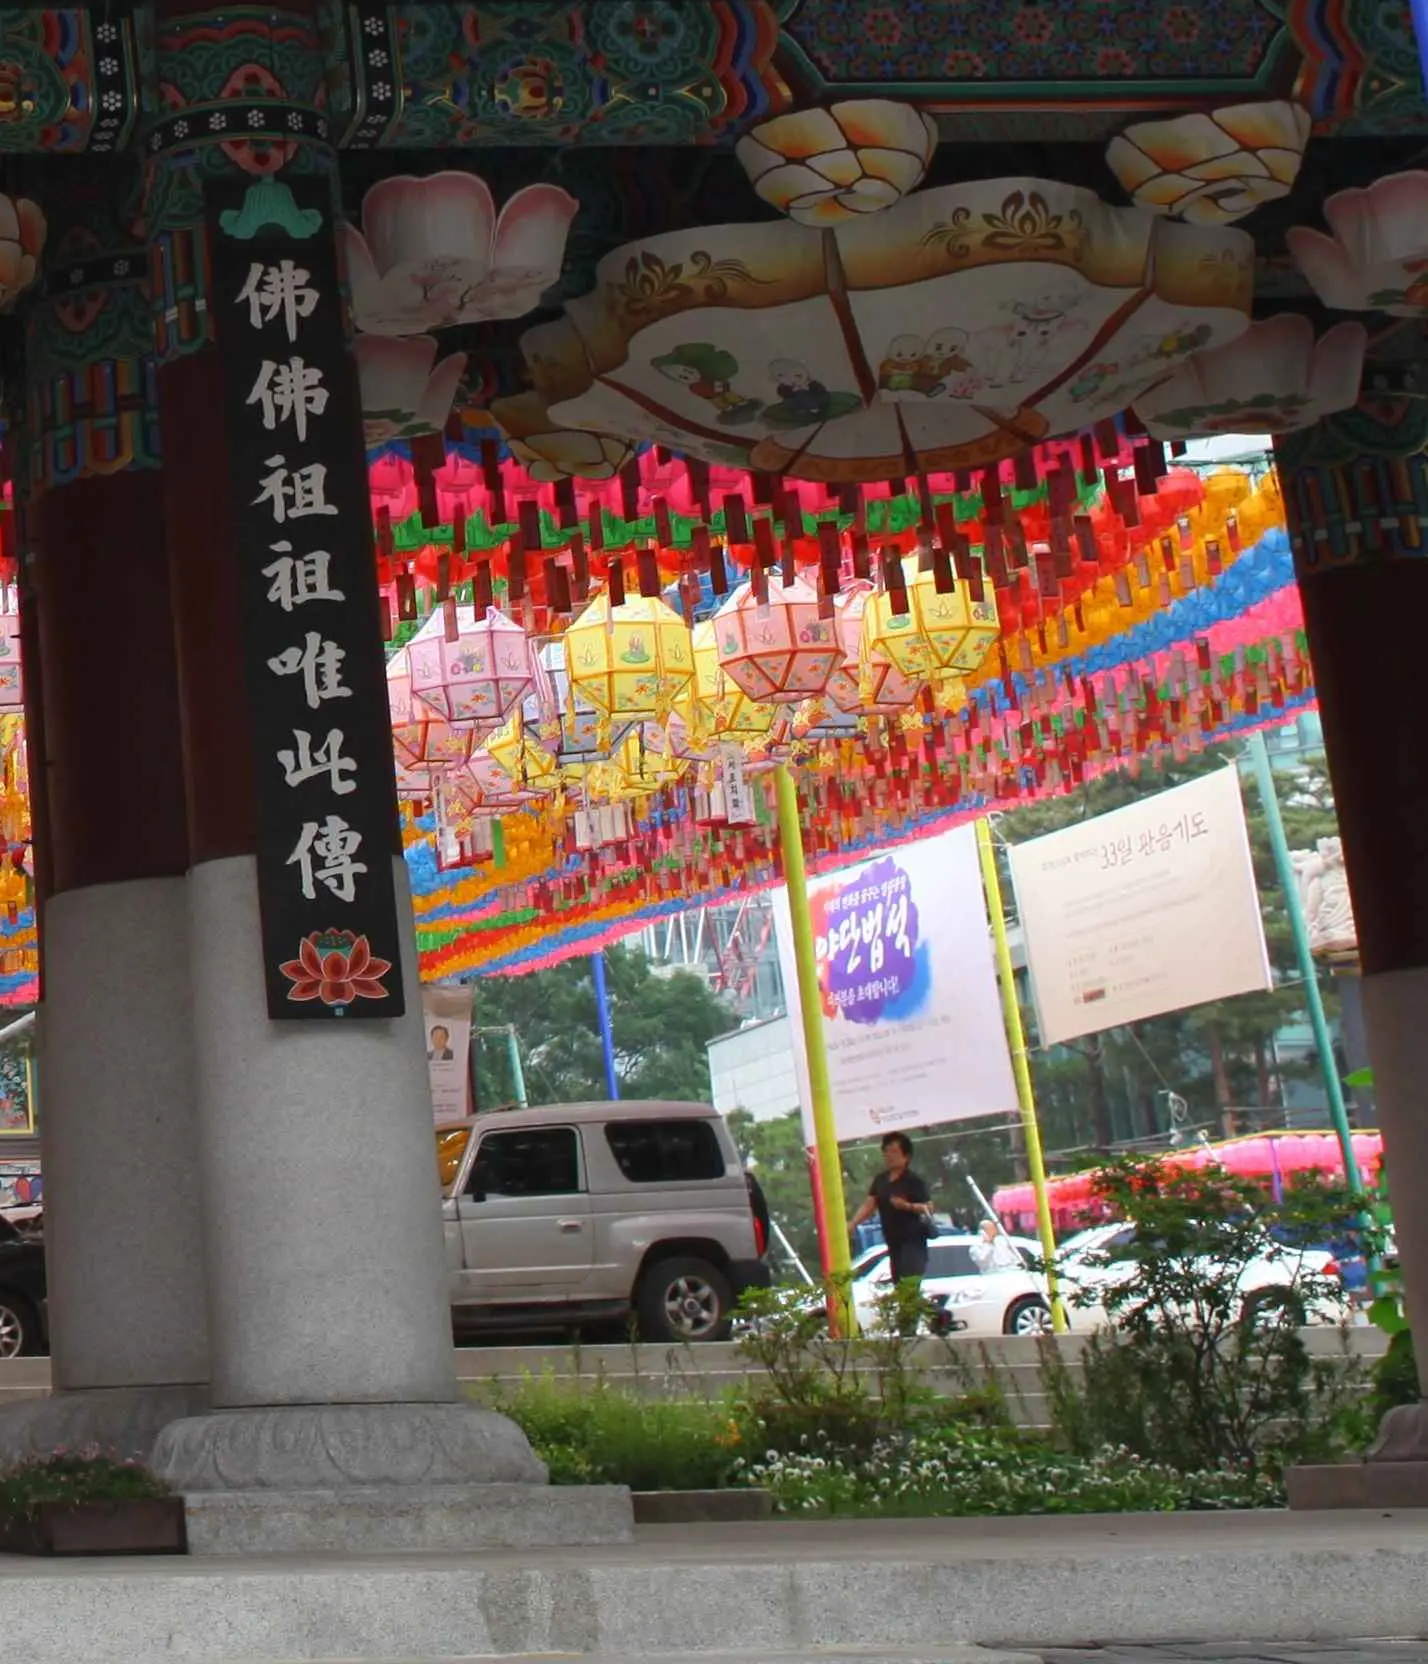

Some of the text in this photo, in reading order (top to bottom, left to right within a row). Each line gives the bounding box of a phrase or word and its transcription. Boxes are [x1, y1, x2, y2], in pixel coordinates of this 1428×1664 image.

[234, 260, 369, 904] 佛佛祖祖唯此傳
[1101, 835, 1133, 869] 33일
[816, 894, 911, 974] 야단법석
